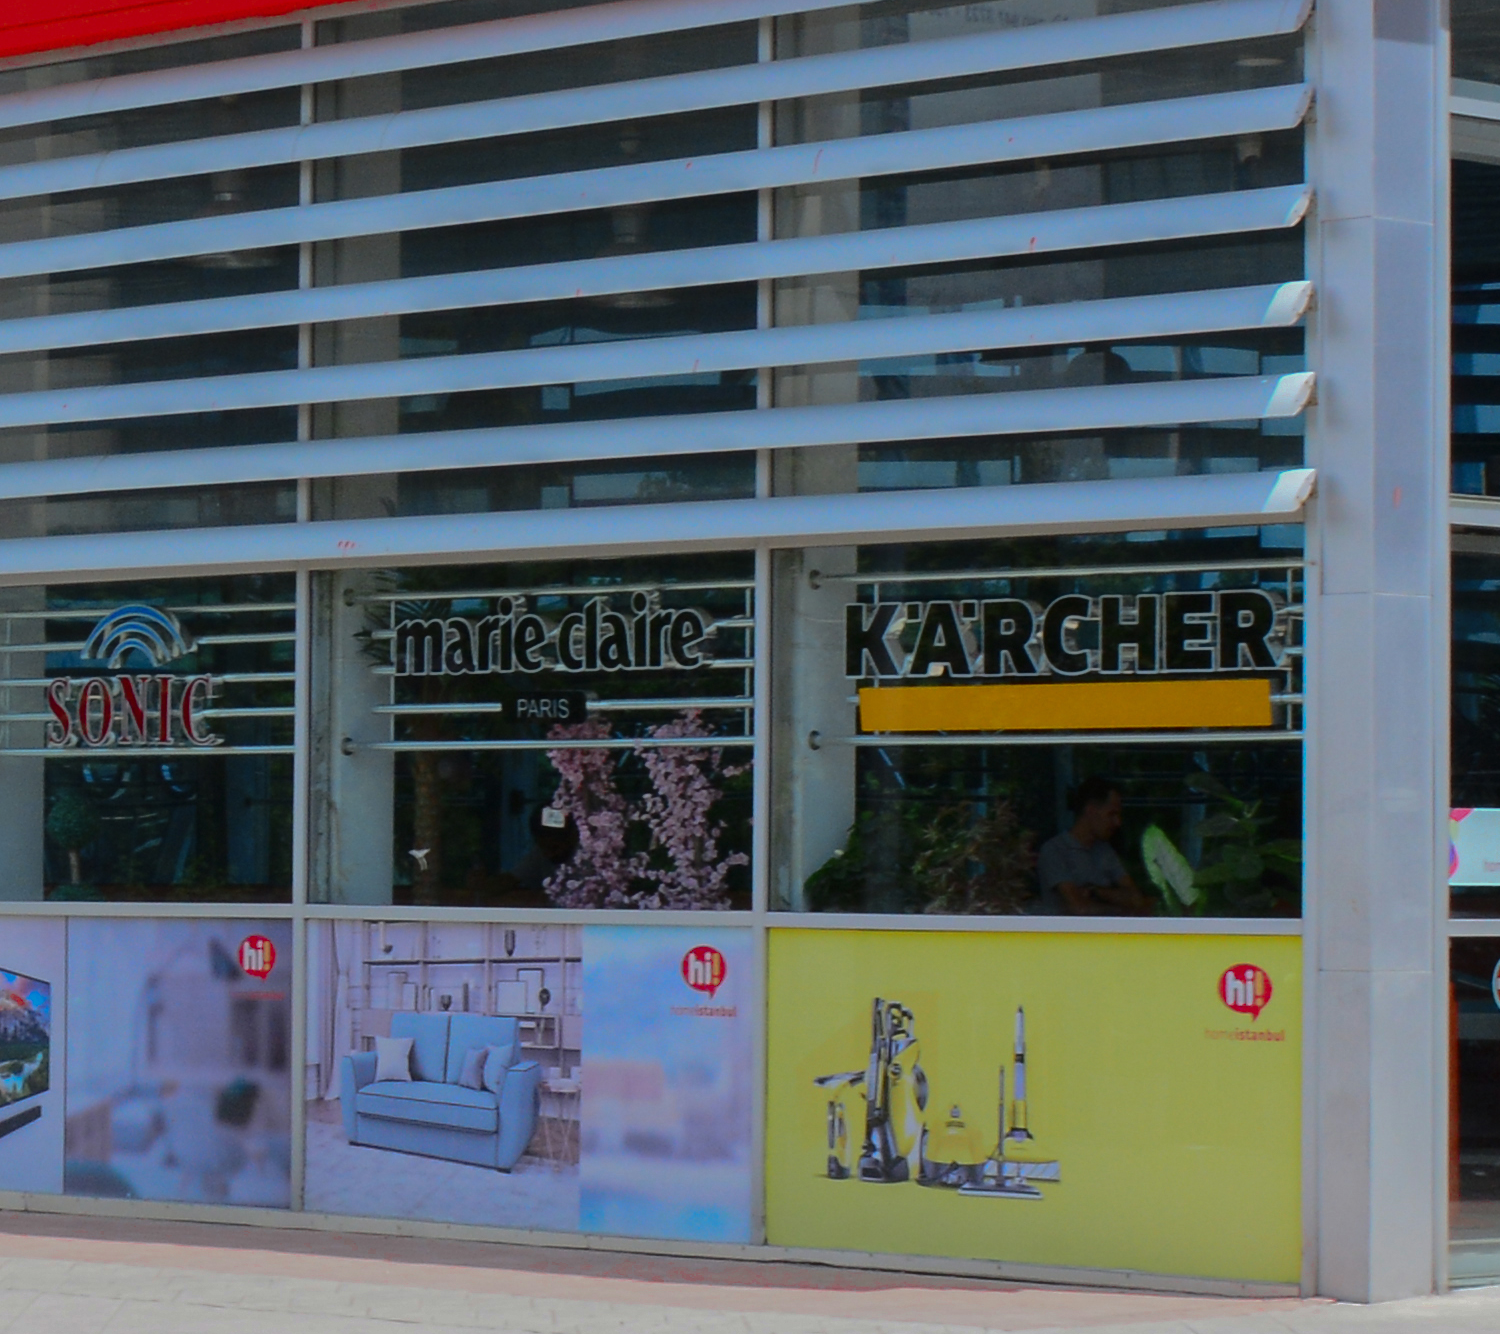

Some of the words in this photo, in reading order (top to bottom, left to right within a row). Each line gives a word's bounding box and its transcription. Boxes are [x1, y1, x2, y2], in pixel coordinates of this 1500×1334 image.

[394, 593, 547, 677] marie
[557, 590, 707, 674] claire
[845, 589, 1286, 678] KÄRCHER
[45, 673, 219, 748] SONIC
[516, 698, 569, 719] PARIS
[688, 951, 721, 986] hi!
[1224, 968, 1265, 1007] hi!
